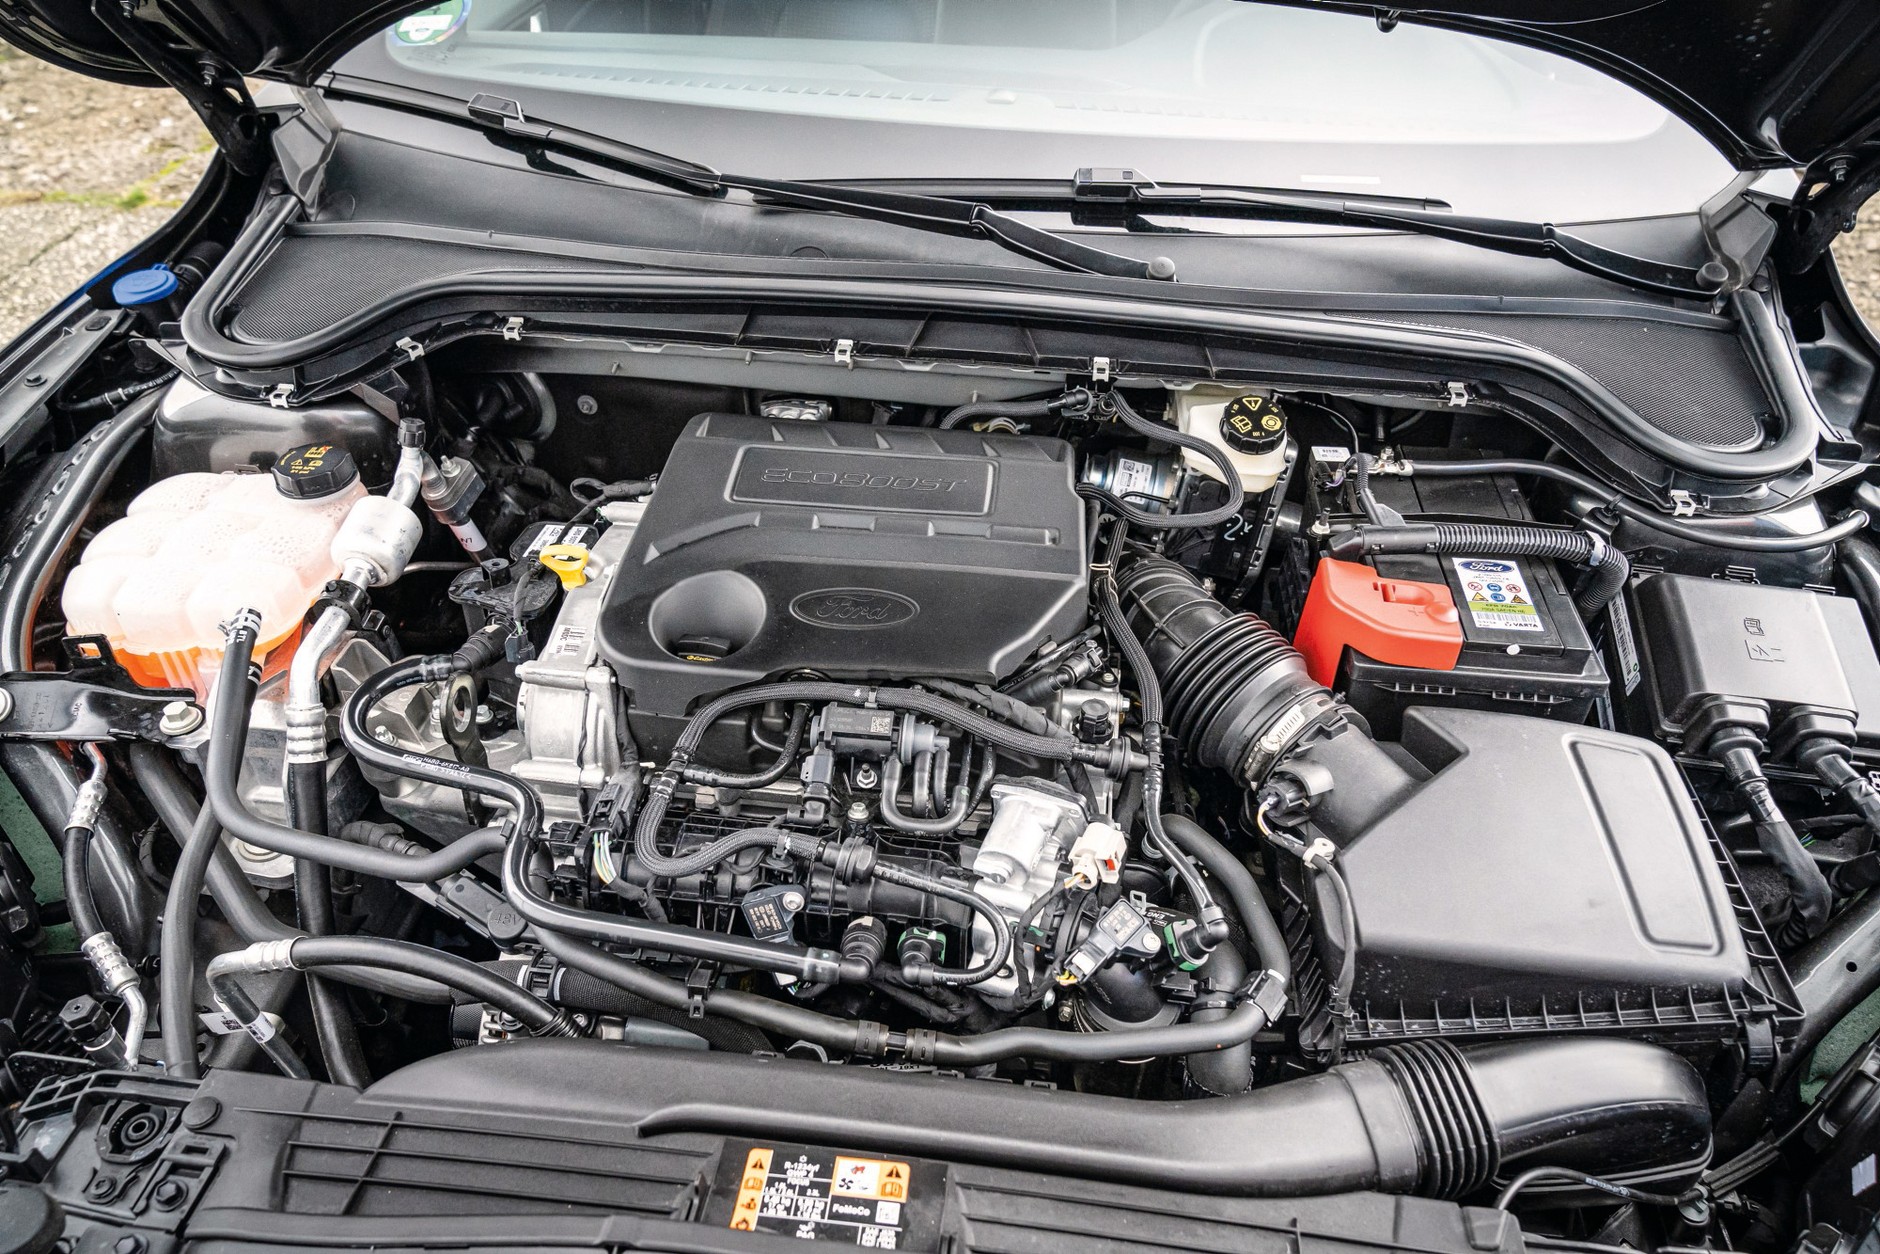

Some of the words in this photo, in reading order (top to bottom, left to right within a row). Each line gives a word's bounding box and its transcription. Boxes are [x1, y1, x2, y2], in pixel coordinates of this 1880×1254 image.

[761, 468, 967, 491] ECOBOOST
[1469, 561, 1504, 572] Ford
[816, 594, 890, 620] Ford
[833, 1204, 870, 1216] FoMoCo
